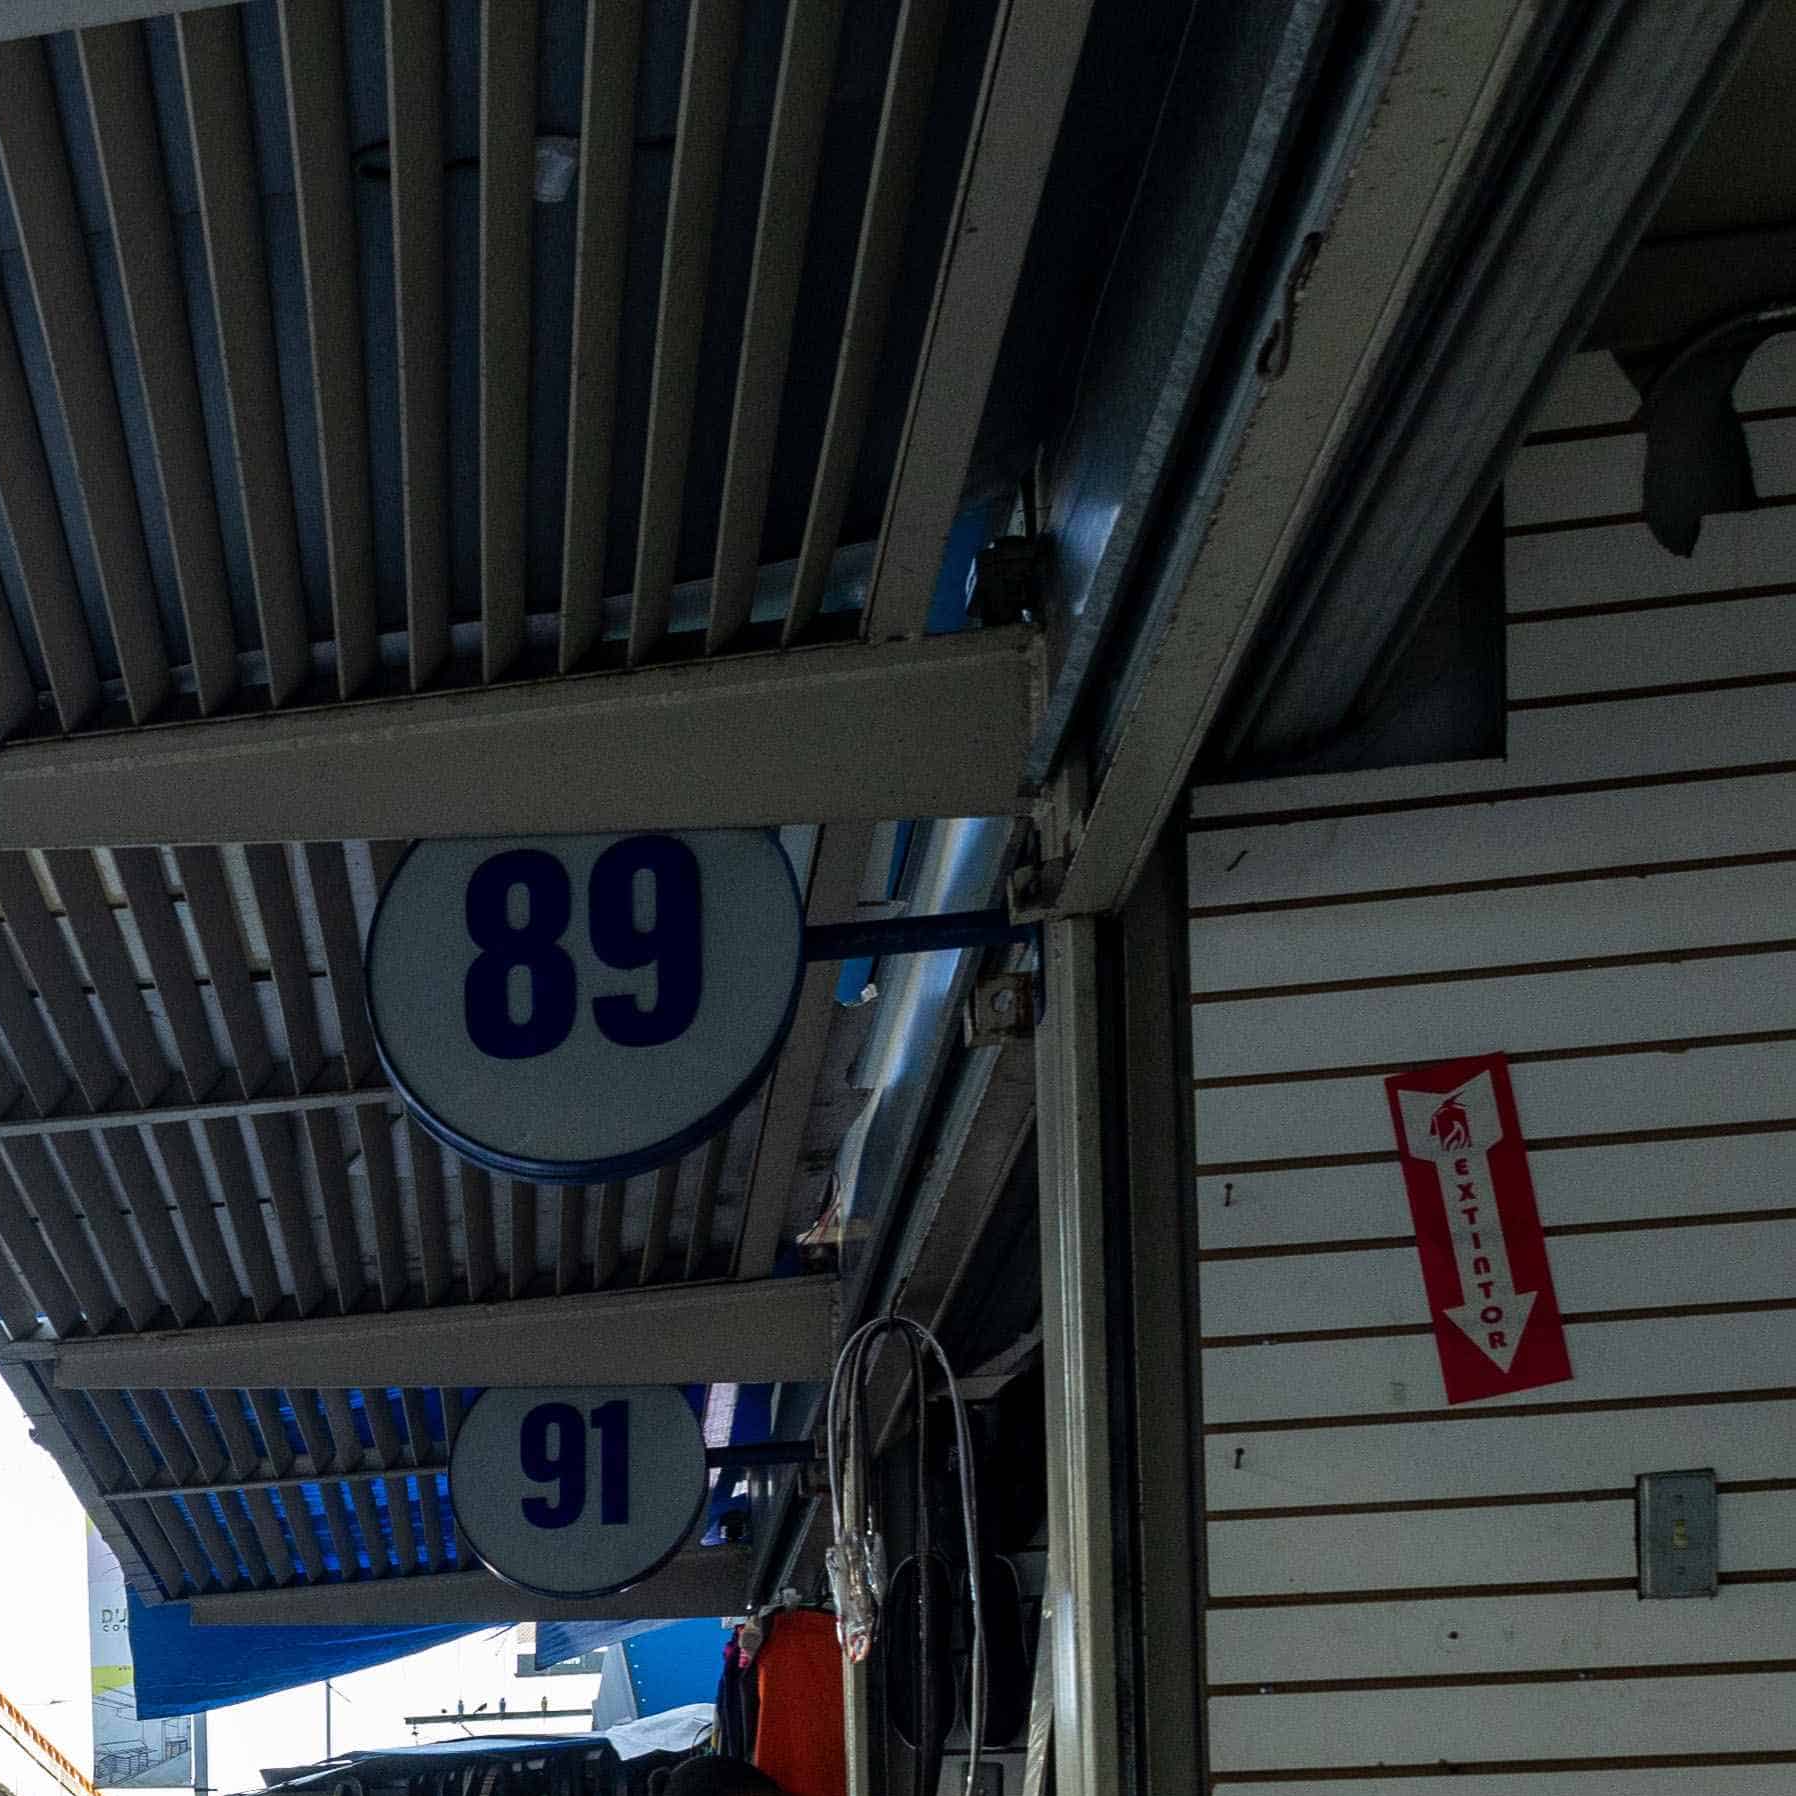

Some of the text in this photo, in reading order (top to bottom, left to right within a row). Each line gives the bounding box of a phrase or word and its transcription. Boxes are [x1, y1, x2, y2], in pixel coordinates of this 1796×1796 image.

[464, 835, 702, 1059] 89
[1455, 1158, 1507, 1348] EXTINTOR
[520, 1401, 629, 1529] 91
